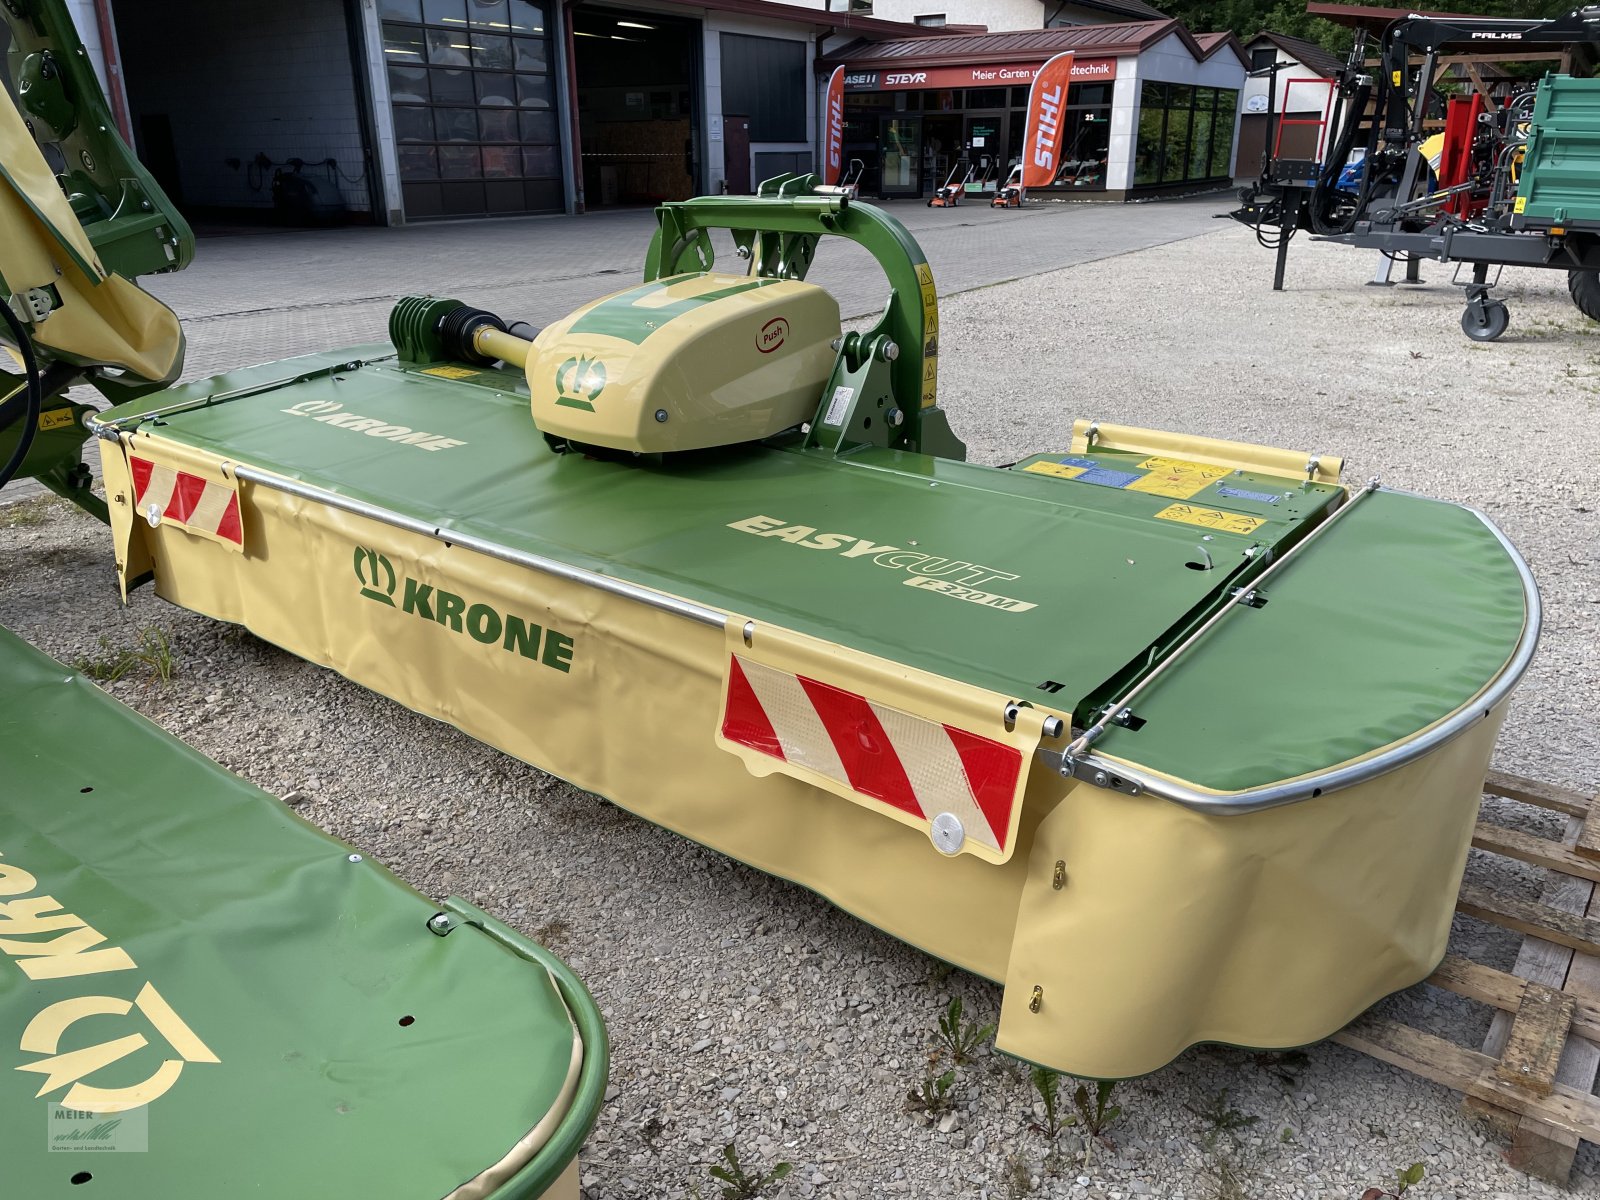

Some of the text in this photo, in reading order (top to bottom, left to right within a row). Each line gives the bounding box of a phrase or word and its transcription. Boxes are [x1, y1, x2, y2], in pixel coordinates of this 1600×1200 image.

[843, 75, 866, 85] ASE
[885, 72, 927, 85] STEYR
[972, 70, 997, 80] Meier
[999, 68, 1030, 79] Garten
[1070, 63, 1110, 75] dtechnik
[1034, 85, 1062, 171] STIHL
[1085, 113, 1095, 121] 25
[829, 94, 841, 169] STIHL
[763, 325, 783, 345] Push
[312, 412, 469, 452] KRONE
[916, 579, 1020, 609] F 320 M
[402, 576, 575, 674] KRONE
